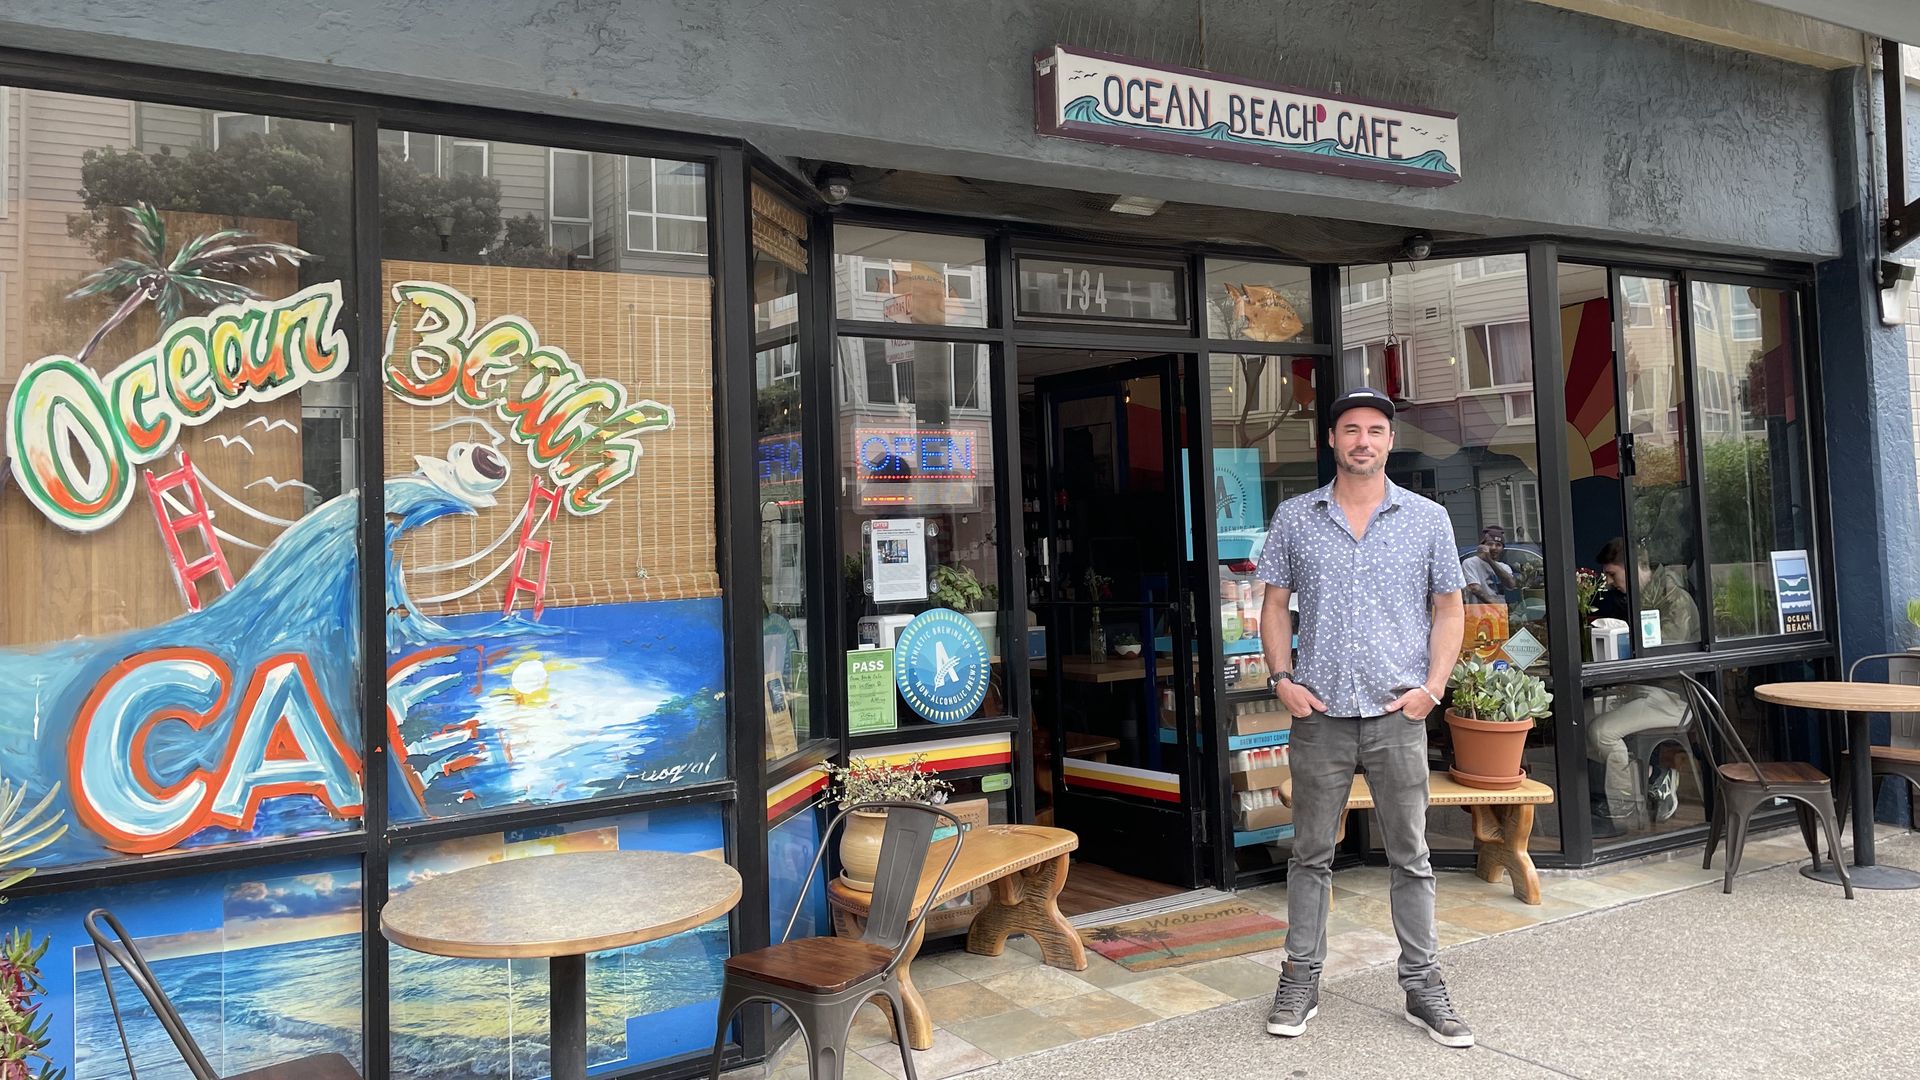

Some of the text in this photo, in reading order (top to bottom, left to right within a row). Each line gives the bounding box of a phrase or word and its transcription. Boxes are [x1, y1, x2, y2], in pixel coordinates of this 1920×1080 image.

[1103, 74, 1403, 159] OCEAN BEACH CAFE
[1063, 268, 1108, 313] 734
[7, 279, 675, 532] Ocean Beach
[860, 436, 971, 471] OPEN
[1786, 614, 1812, 632] OCEAN BEACH
[852, 659, 885, 673] PASS
[910, 631, 931, 666] ATHLETIC
[932, 625, 963, 641] BREWING
[915, 664, 977, 706] NON-ALCOHOLIC BREWS
[1147, 905, 1250, 930] Welcome
